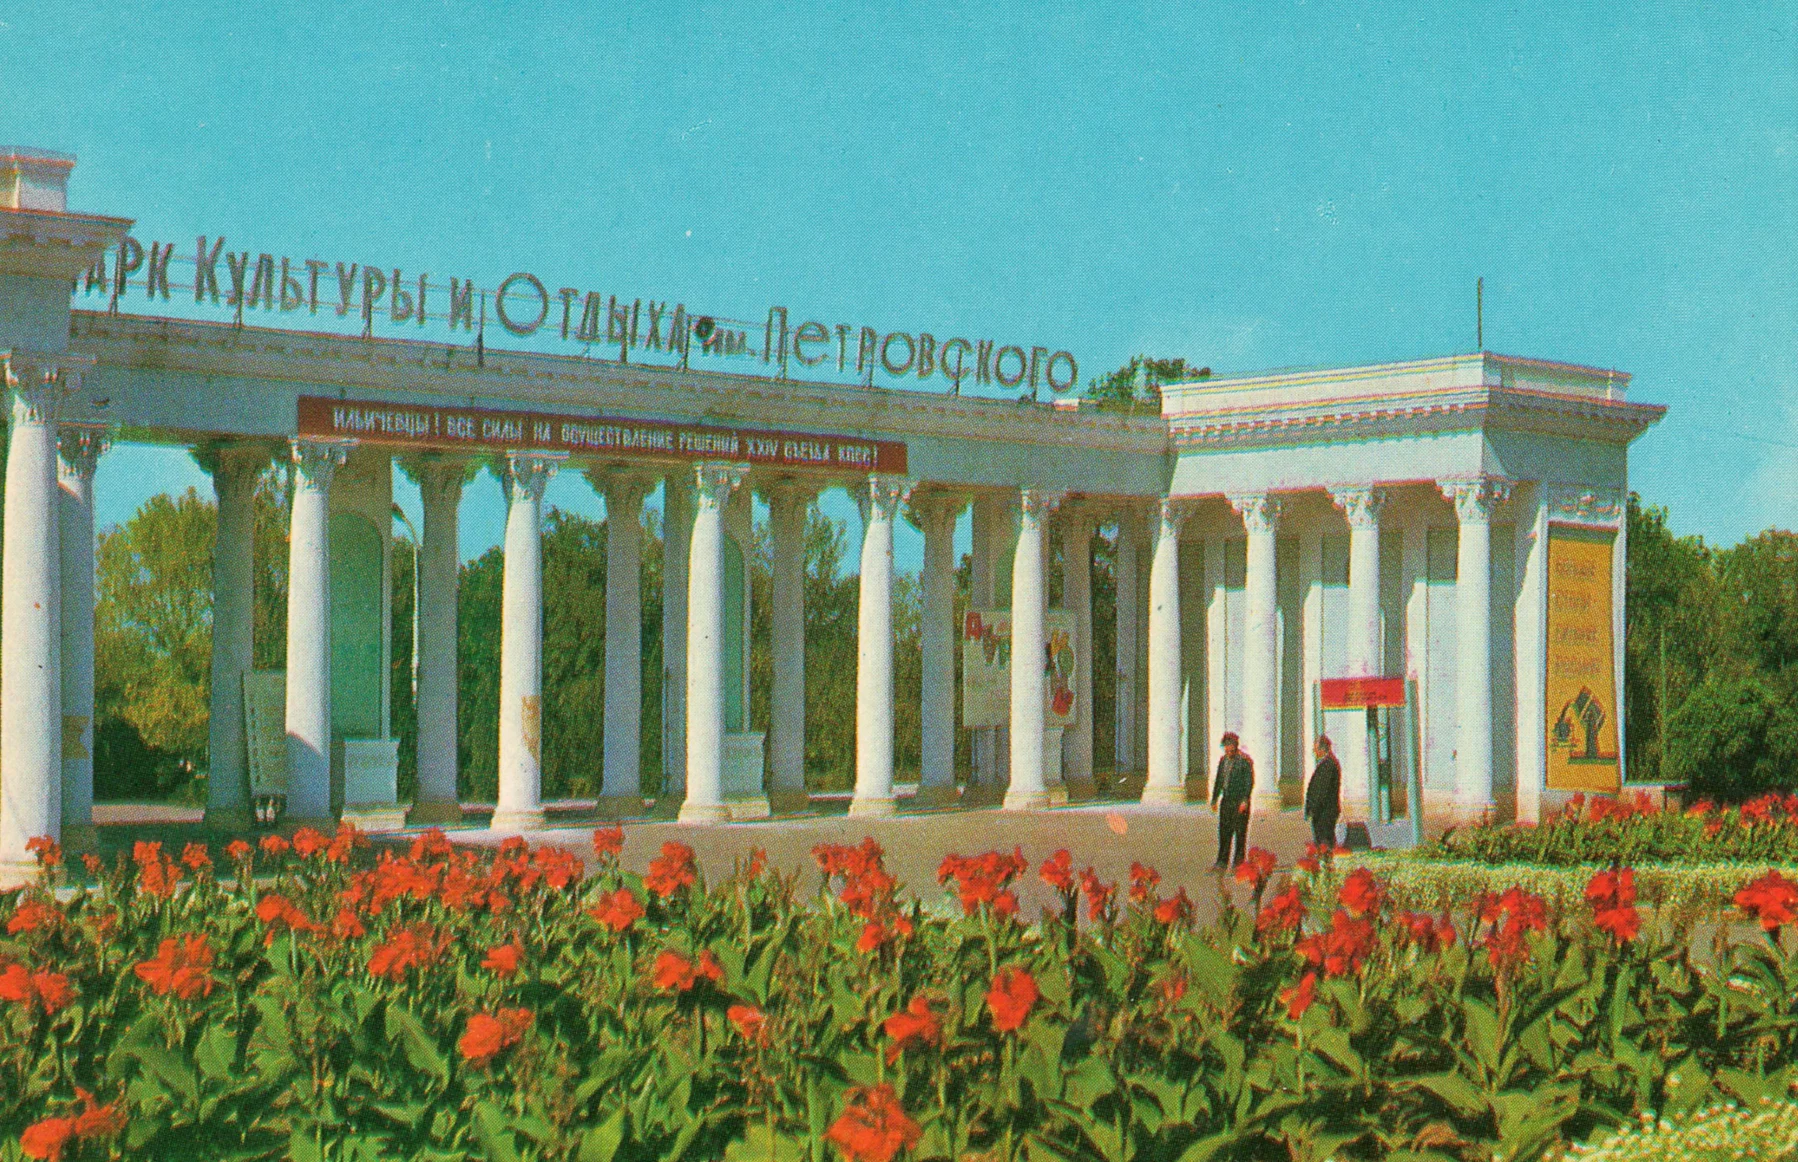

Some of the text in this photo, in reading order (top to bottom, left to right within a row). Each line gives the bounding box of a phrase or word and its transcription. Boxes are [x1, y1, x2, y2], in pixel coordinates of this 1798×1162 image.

[72, 236, 174, 300] АРК
[446, 415, 476, 439] ВСЕ
[482, 418, 523, 441] СИЛЫ
[533, 421, 552, 443] НА
[561, 423, 674, 450] ОСУЩЕСТВЛЕНИЕ
[678, 431, 739, 455] РЕШЕНИЙ
